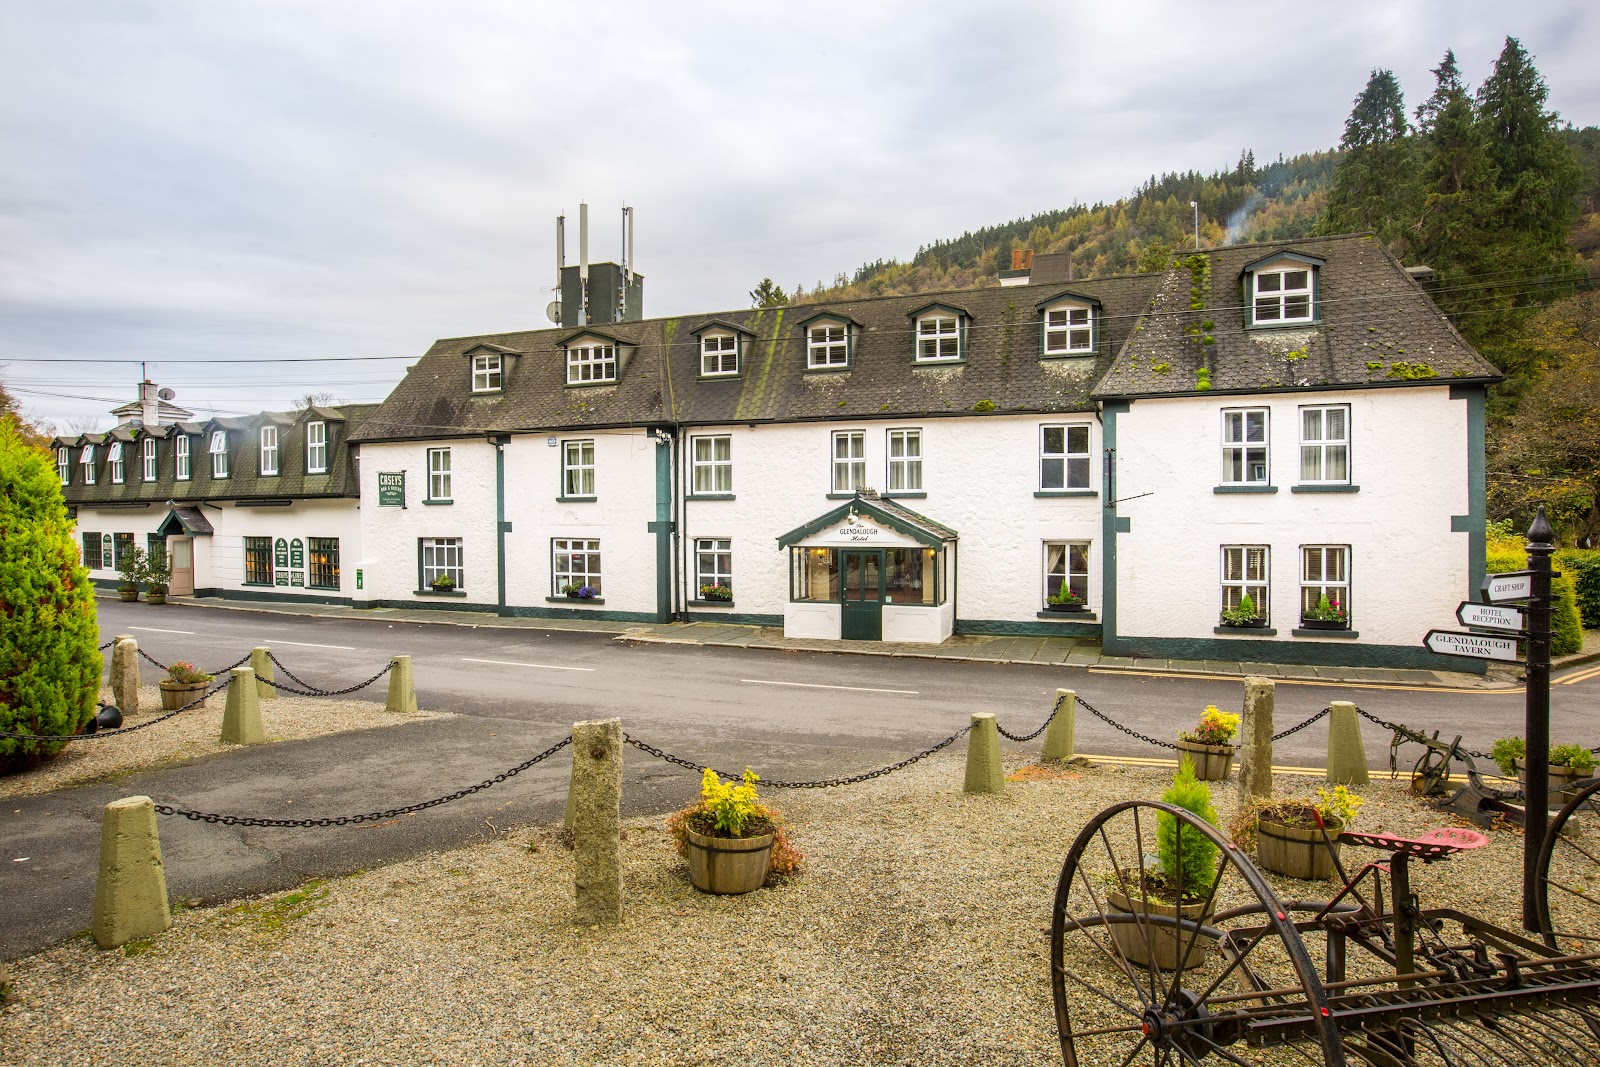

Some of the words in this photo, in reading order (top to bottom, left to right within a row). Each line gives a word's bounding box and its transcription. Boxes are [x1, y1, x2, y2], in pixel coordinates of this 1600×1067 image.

[1494, 584, 1511, 593] CRAFT
[1511, 583, 1525, 591] SHOP
[1480, 608, 1503, 617] HOTEL
[1472, 614, 1511, 626] RECEPTION
[1435, 635, 1511, 650] GLENDALOUGH
[1453, 644, 1491, 655] TAVERN
